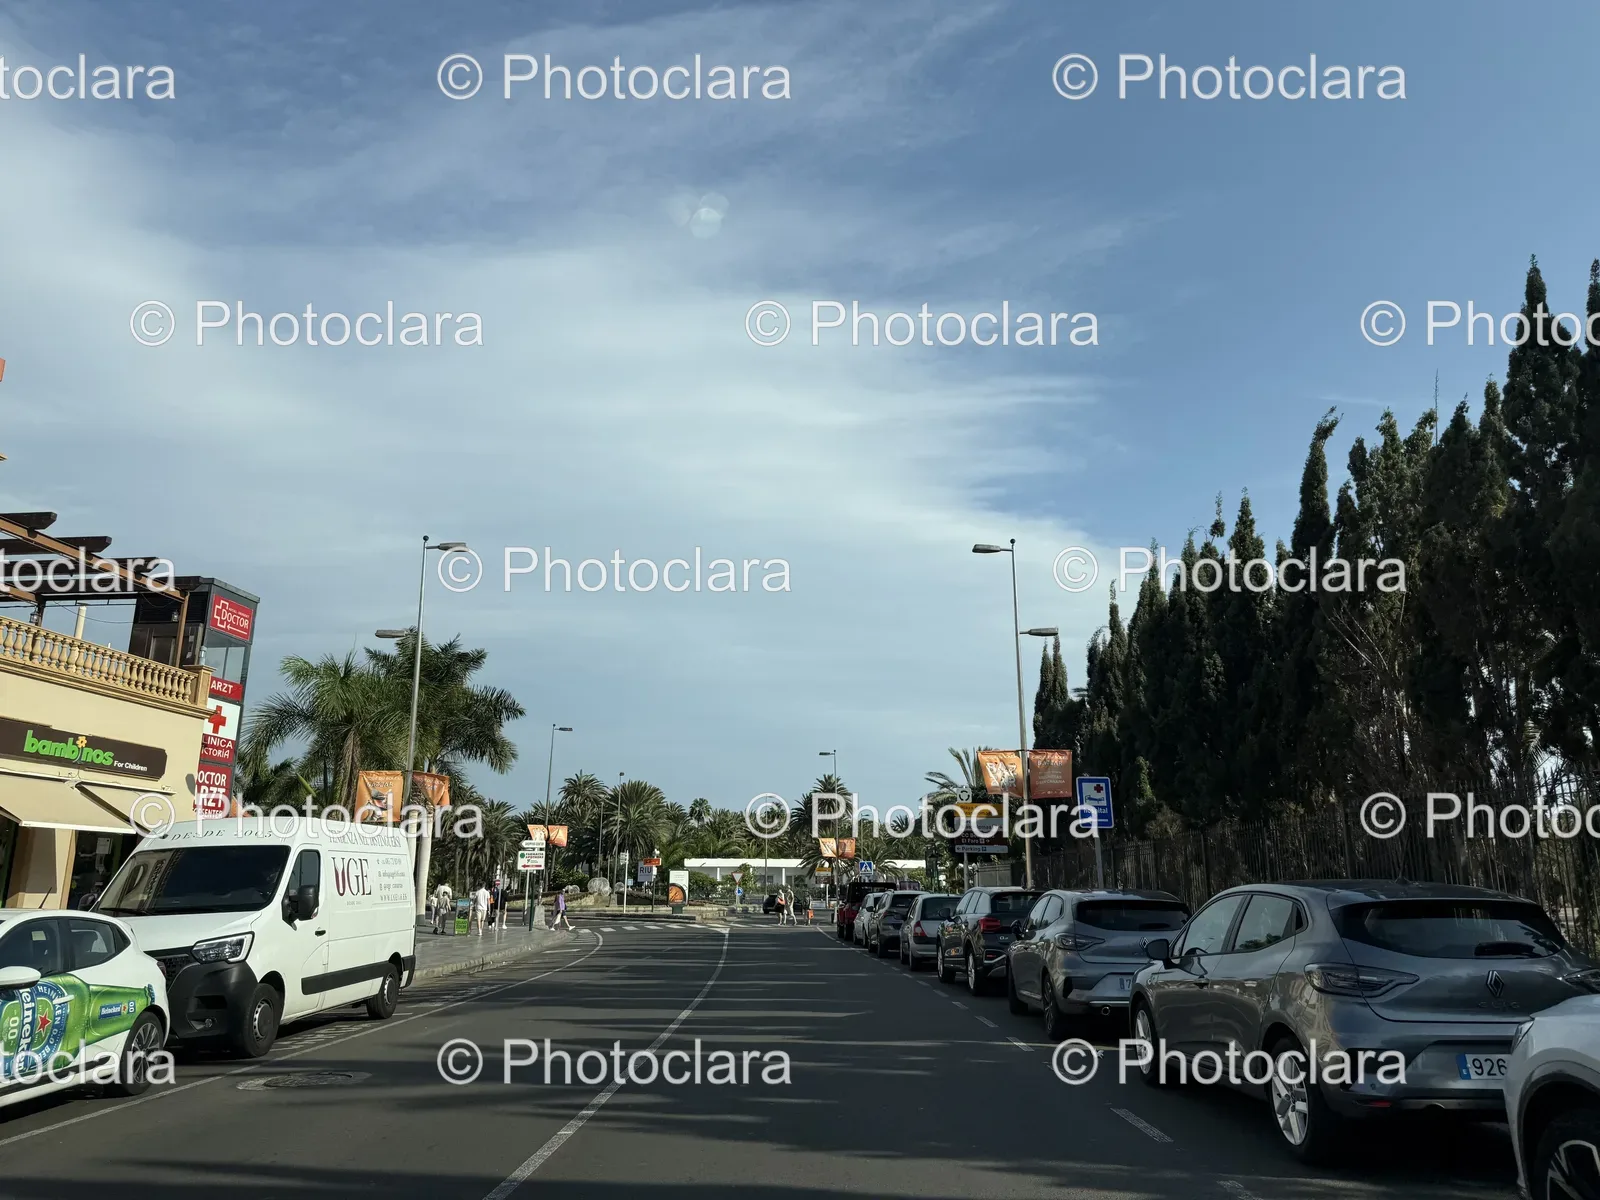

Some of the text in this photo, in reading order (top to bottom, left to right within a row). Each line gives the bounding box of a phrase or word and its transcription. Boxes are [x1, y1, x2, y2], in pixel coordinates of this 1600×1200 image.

[221, 609, 249, 629] DOCTOR
[210, 680, 233, 694] ARZT
[24, 730, 114, 766] bambinos
[114, 760, 148, 771] For Children
[331, 856, 372, 896] UGE
[15, 987, 35, 1072] eineken
